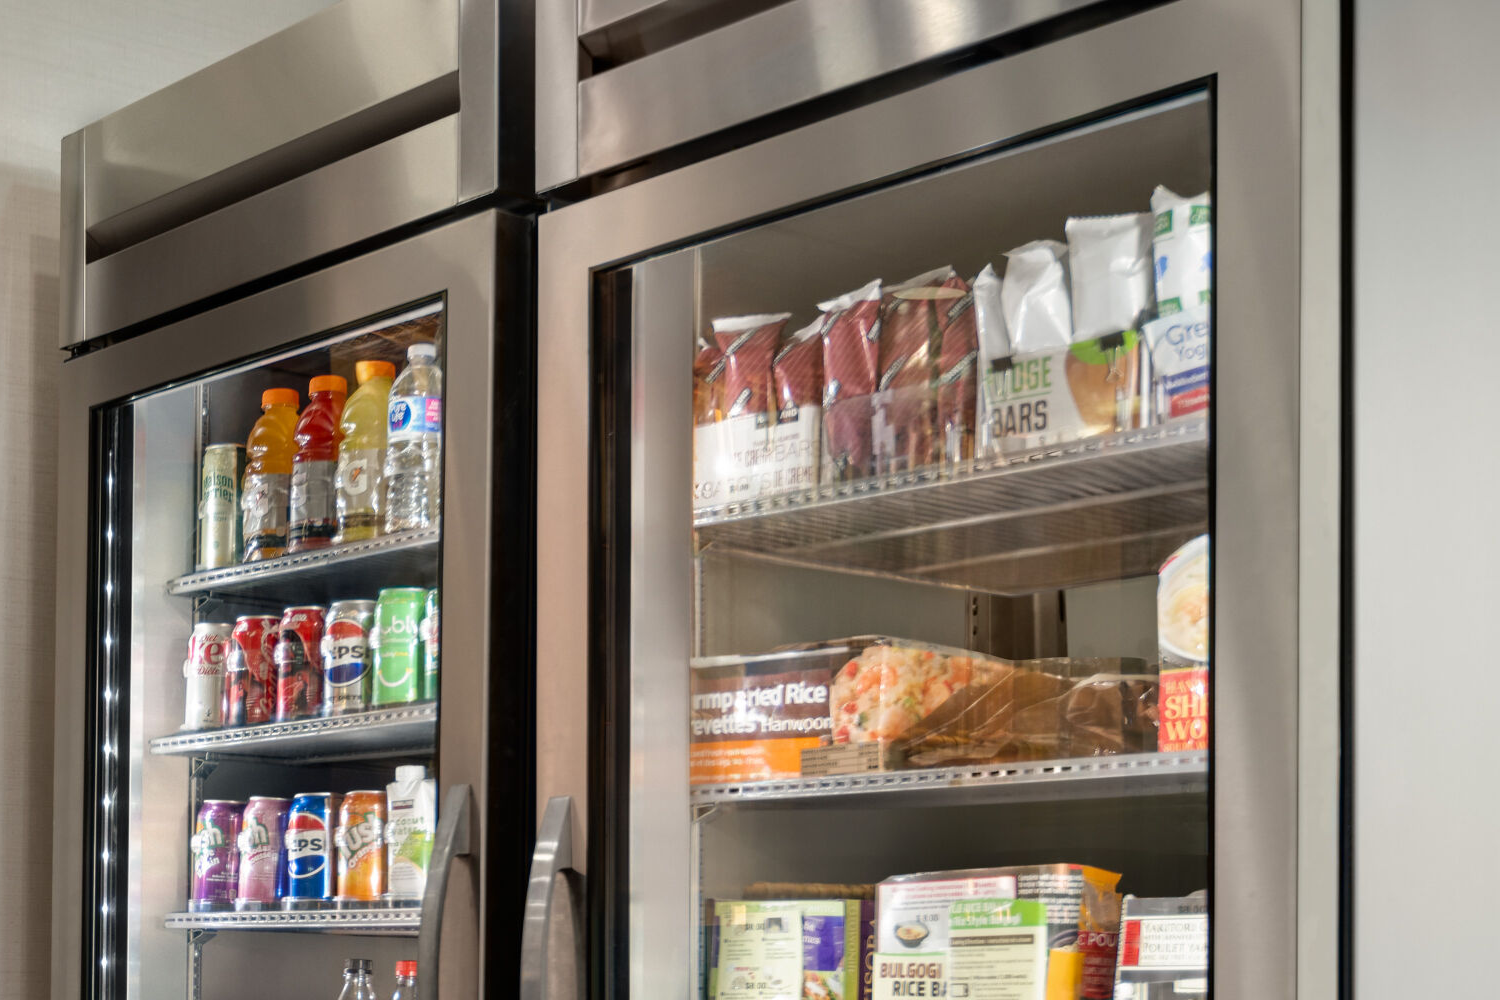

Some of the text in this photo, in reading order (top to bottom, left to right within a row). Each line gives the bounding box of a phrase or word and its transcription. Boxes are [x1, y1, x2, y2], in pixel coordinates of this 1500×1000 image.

[1165, 321, 1208, 346] Gre
[986, 356, 1053, 402] FDGE
[390, 402, 407, 414] Pure
[992, 400, 1047, 438] BARS
[203, 473, 235, 490] Maison
[344, 459, 368, 496] G
[785, 681, 828, 705] Rice
[880, 962, 942, 979] BULGOGI
[892, 981, 925, 997] RICE
